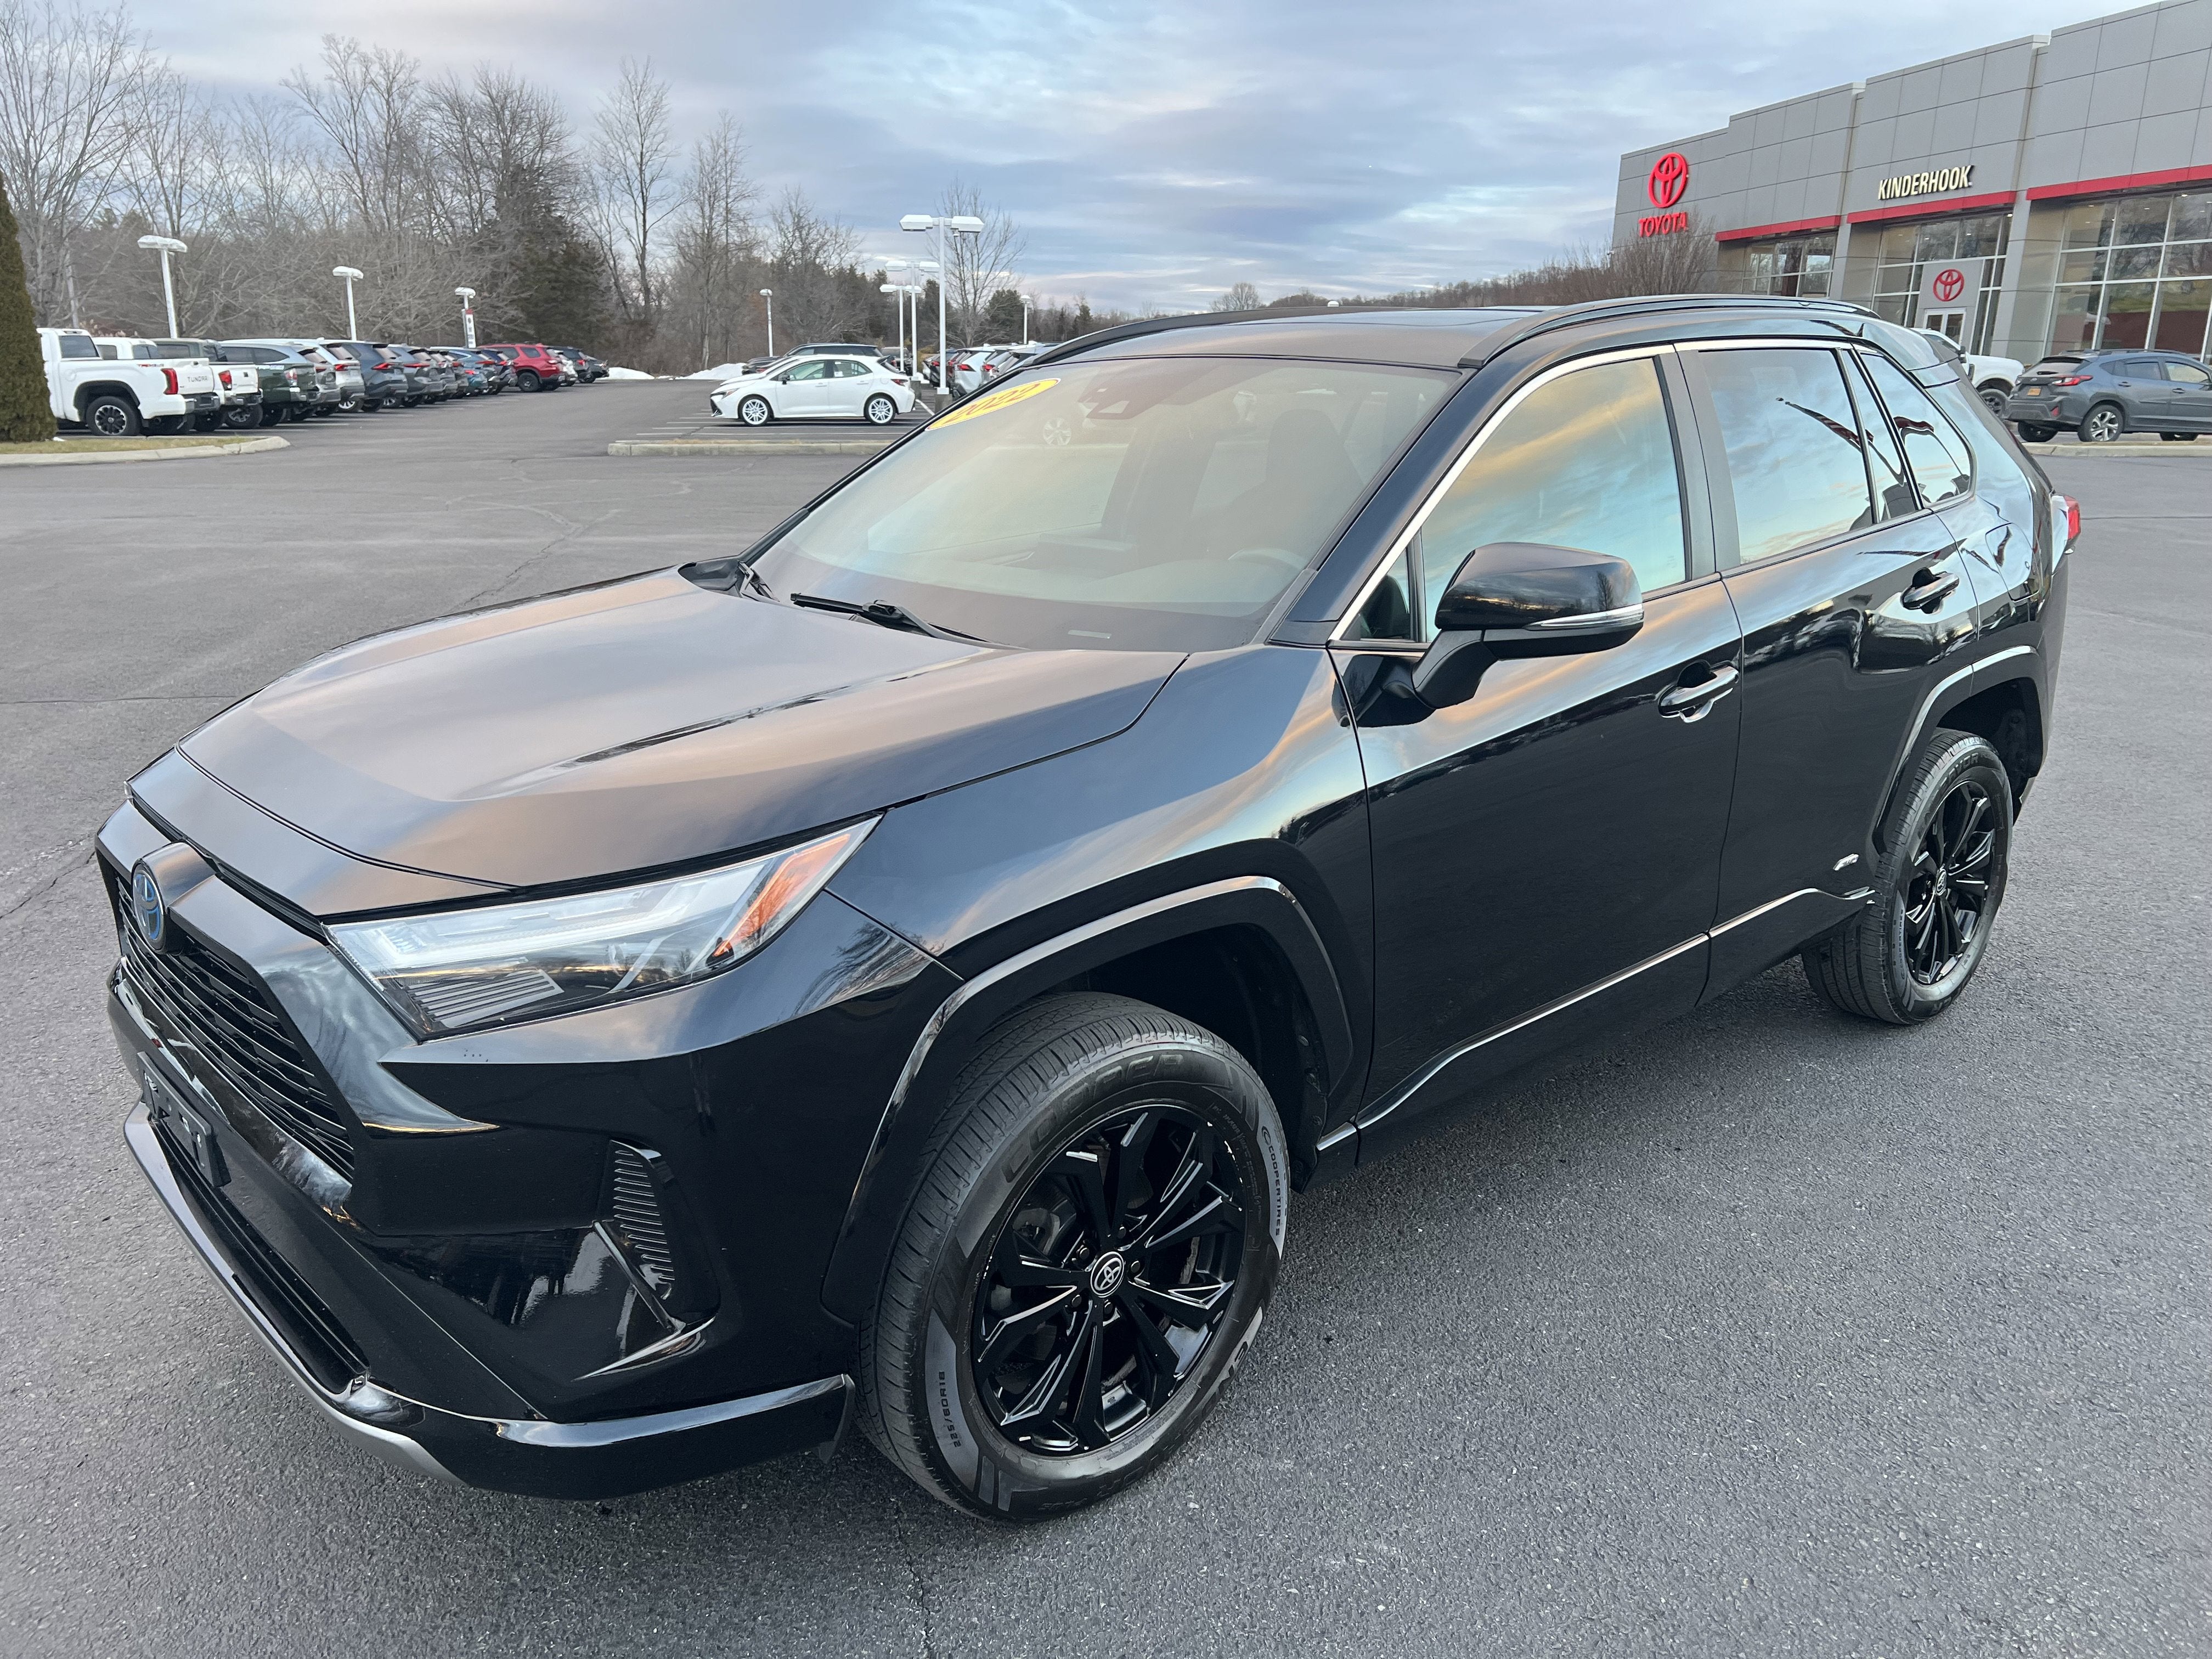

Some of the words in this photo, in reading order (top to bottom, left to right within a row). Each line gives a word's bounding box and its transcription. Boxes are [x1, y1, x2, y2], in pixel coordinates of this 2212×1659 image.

[1878, 165, 1972, 200] KINDERHOOK
[1638, 211, 1686, 237] TOYOTA
[941, 383, 1041, 425] 2022
[1001, 1053, 1184, 1183] COOPER
[1268, 1145, 1281, 1236] COOPERTIRES
[939, 1371, 961, 1448] 225/60R18
